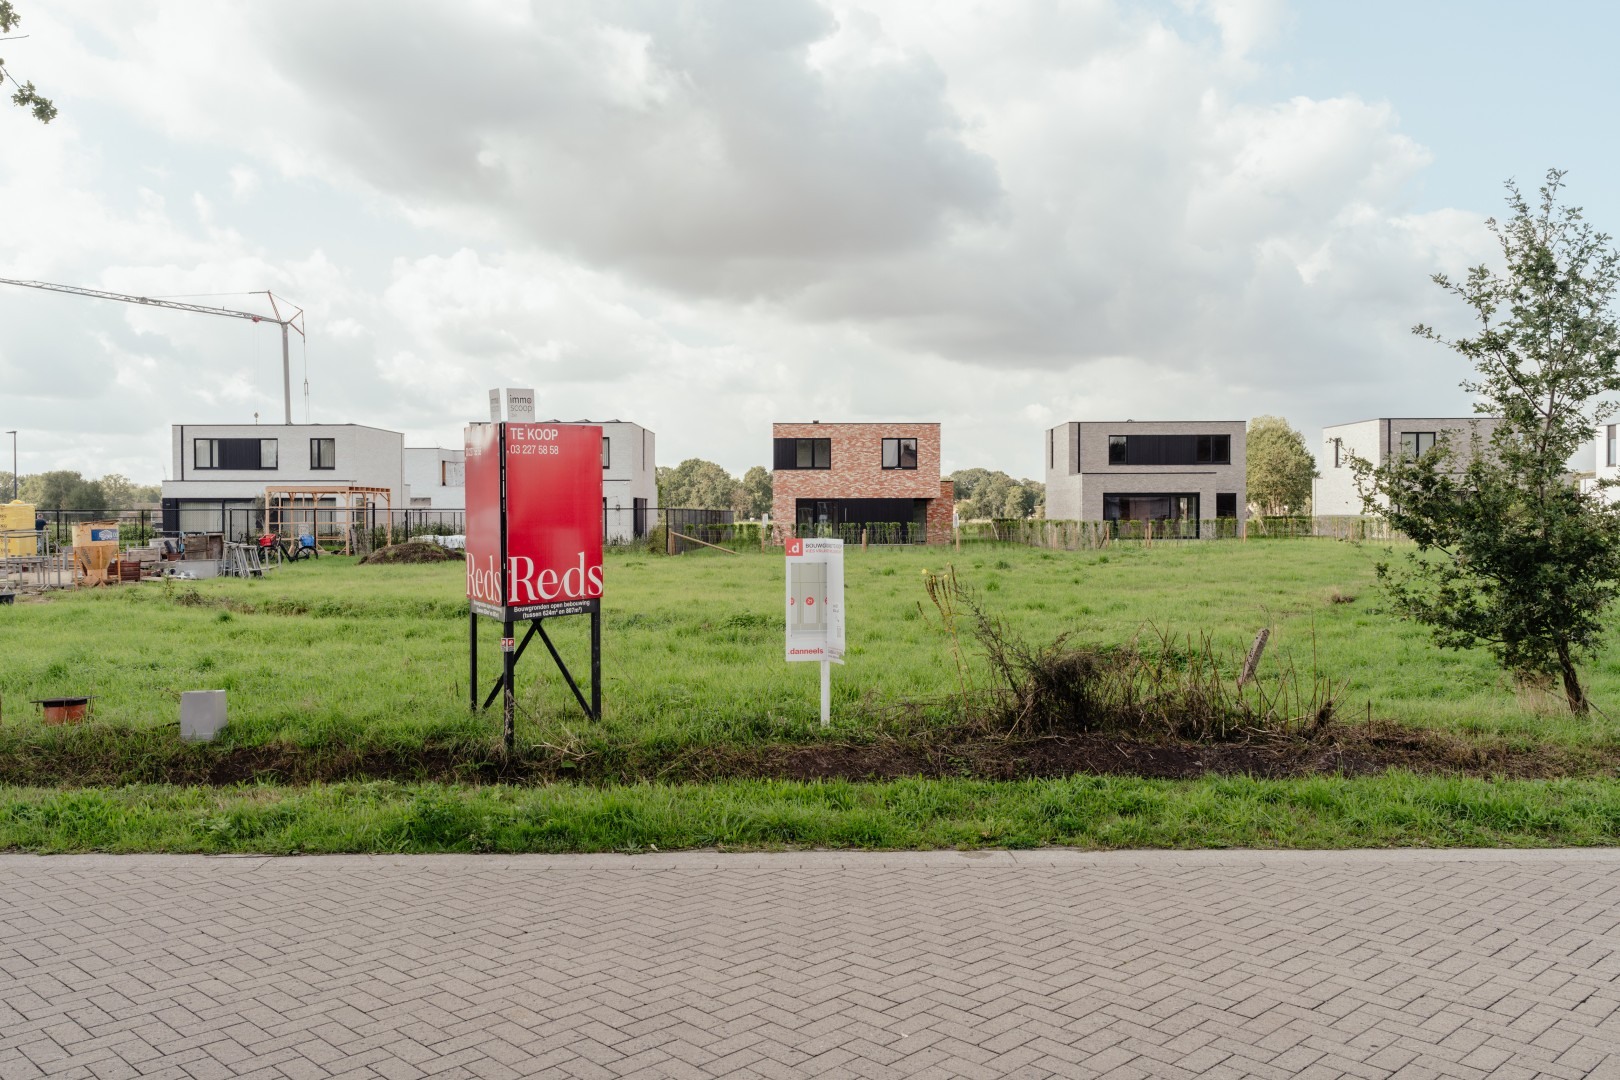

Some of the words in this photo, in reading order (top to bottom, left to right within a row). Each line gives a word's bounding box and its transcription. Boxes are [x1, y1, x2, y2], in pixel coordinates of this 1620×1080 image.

[510, 404, 533, 413] scoop
[510, 428, 525, 440] TE
[527, 428, 559, 441] KOOP
[510, 444, 521, 454] 03
[522, 445, 536, 455] 227
[538, 445, 548, 455] 58
[549, 445, 559, 455] 58
[466, 552, 502, 603] Reds
[508, 551, 602, 603] Reds
[513, 603, 550, 613] Bouwgronden
[563, 600, 591, 608] bebouwing
[522, 610, 542, 619] (tussen
